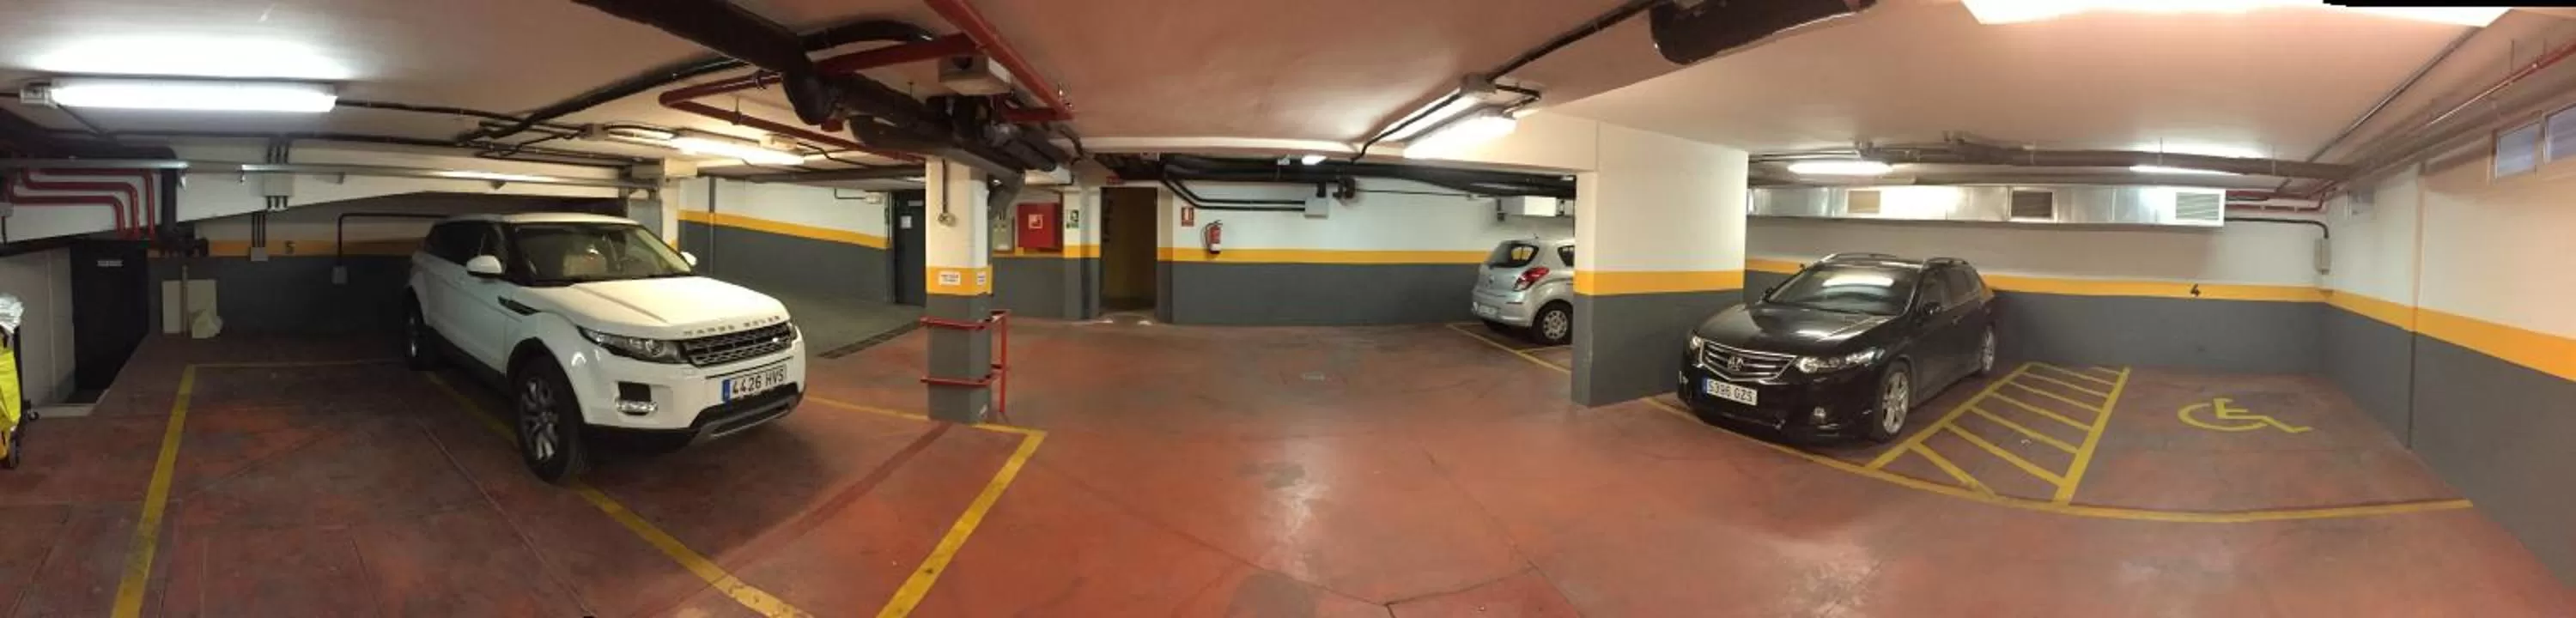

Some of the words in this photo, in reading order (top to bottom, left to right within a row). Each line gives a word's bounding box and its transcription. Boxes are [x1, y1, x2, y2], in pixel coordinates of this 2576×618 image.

[2190, 283, 2202, 297] 4
[732, 374, 762, 394] 4426
[765, 368, 784, 386] HVS
